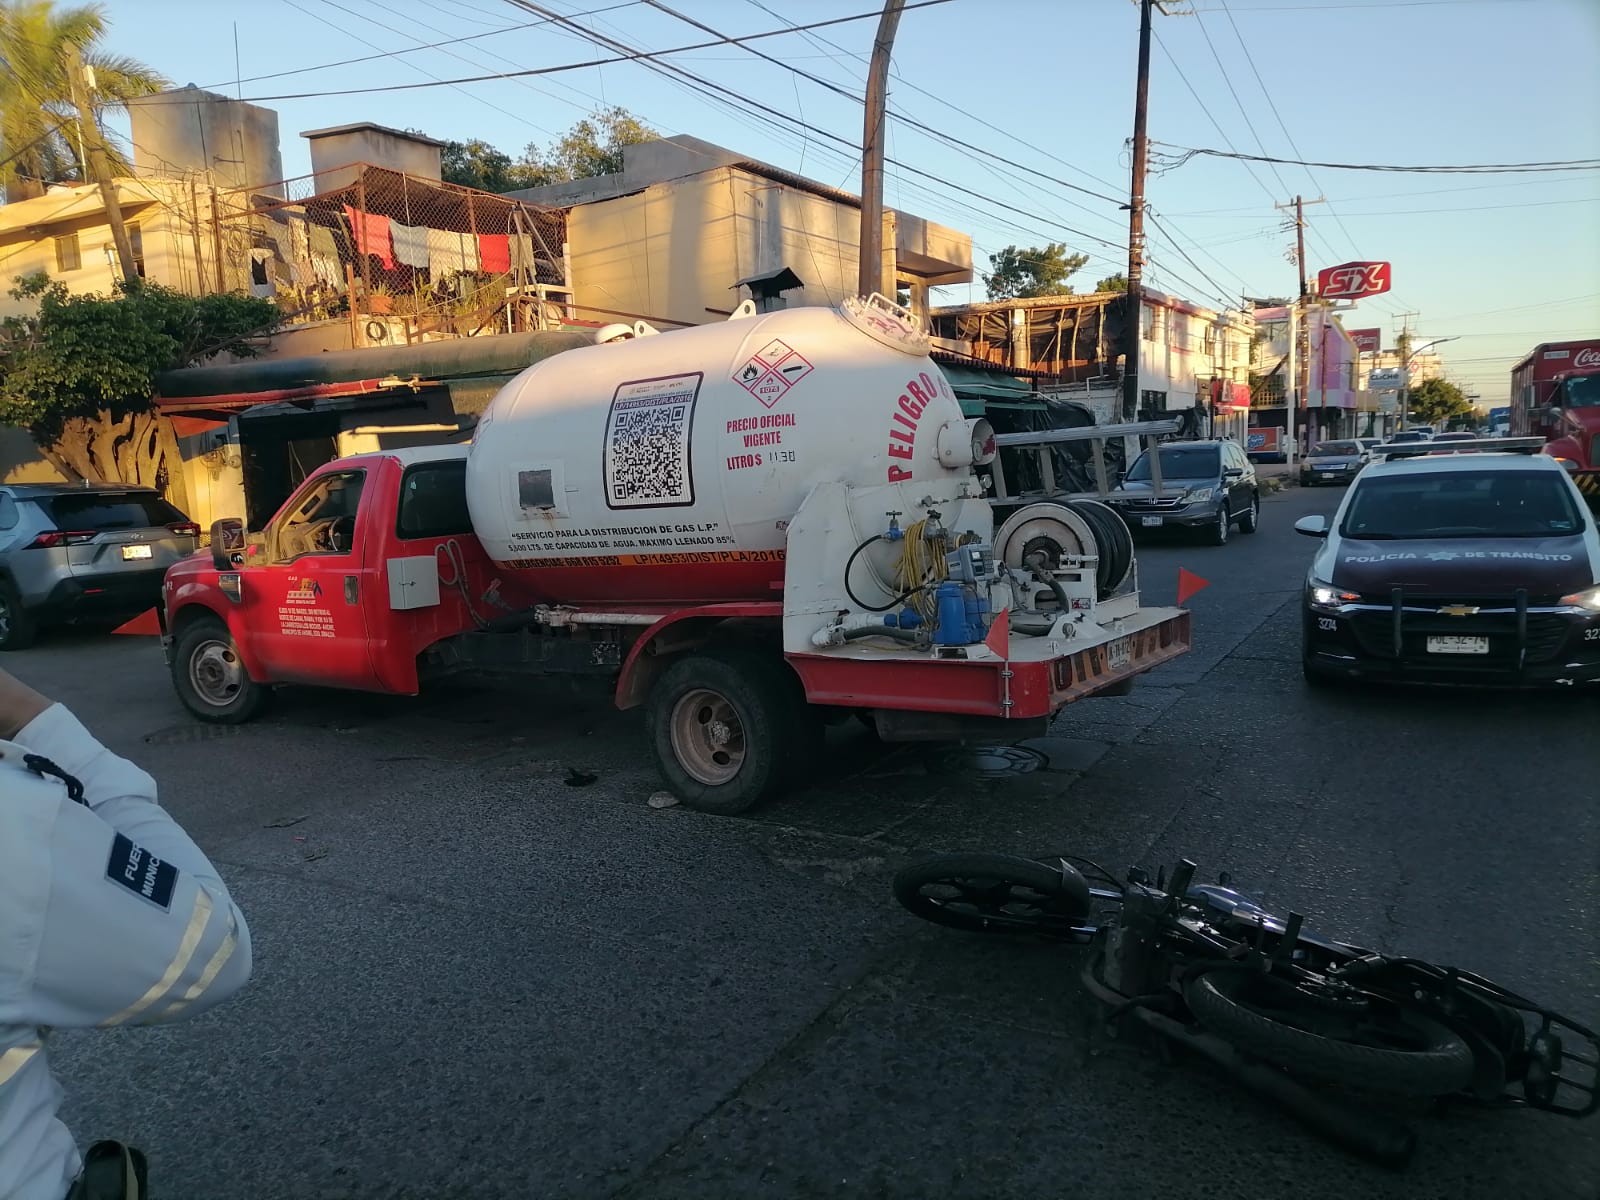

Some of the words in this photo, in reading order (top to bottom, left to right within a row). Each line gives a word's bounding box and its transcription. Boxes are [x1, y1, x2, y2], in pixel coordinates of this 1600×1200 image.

[727, 416, 758, 434] PRECIO
[760, 413, 796, 429] OFICIAL
[888, 372, 938, 483] PELIGRO
[743, 431, 781, 448] VIGENTE
[727, 453, 762, 471] LITROS
[556, 529, 577, 538] PARA
[580, 528, 590, 537] LA
[592, 525, 657, 536] DISTRIBUCION
[660, 525, 672, 534] DE
[674, 524, 695, 533] GAS
[544, 543, 555, 551] DE
[555, 541, 597, 551] CAPACIDAD
[599, 541, 609, 549] DE
[639, 538, 673, 547] MAXIMO
[675, 536, 714, 546] LLENADO
[716, 535, 736, 544] 85%
[633, 550, 785, 565] LP/14953/DIST/PLA/2016
